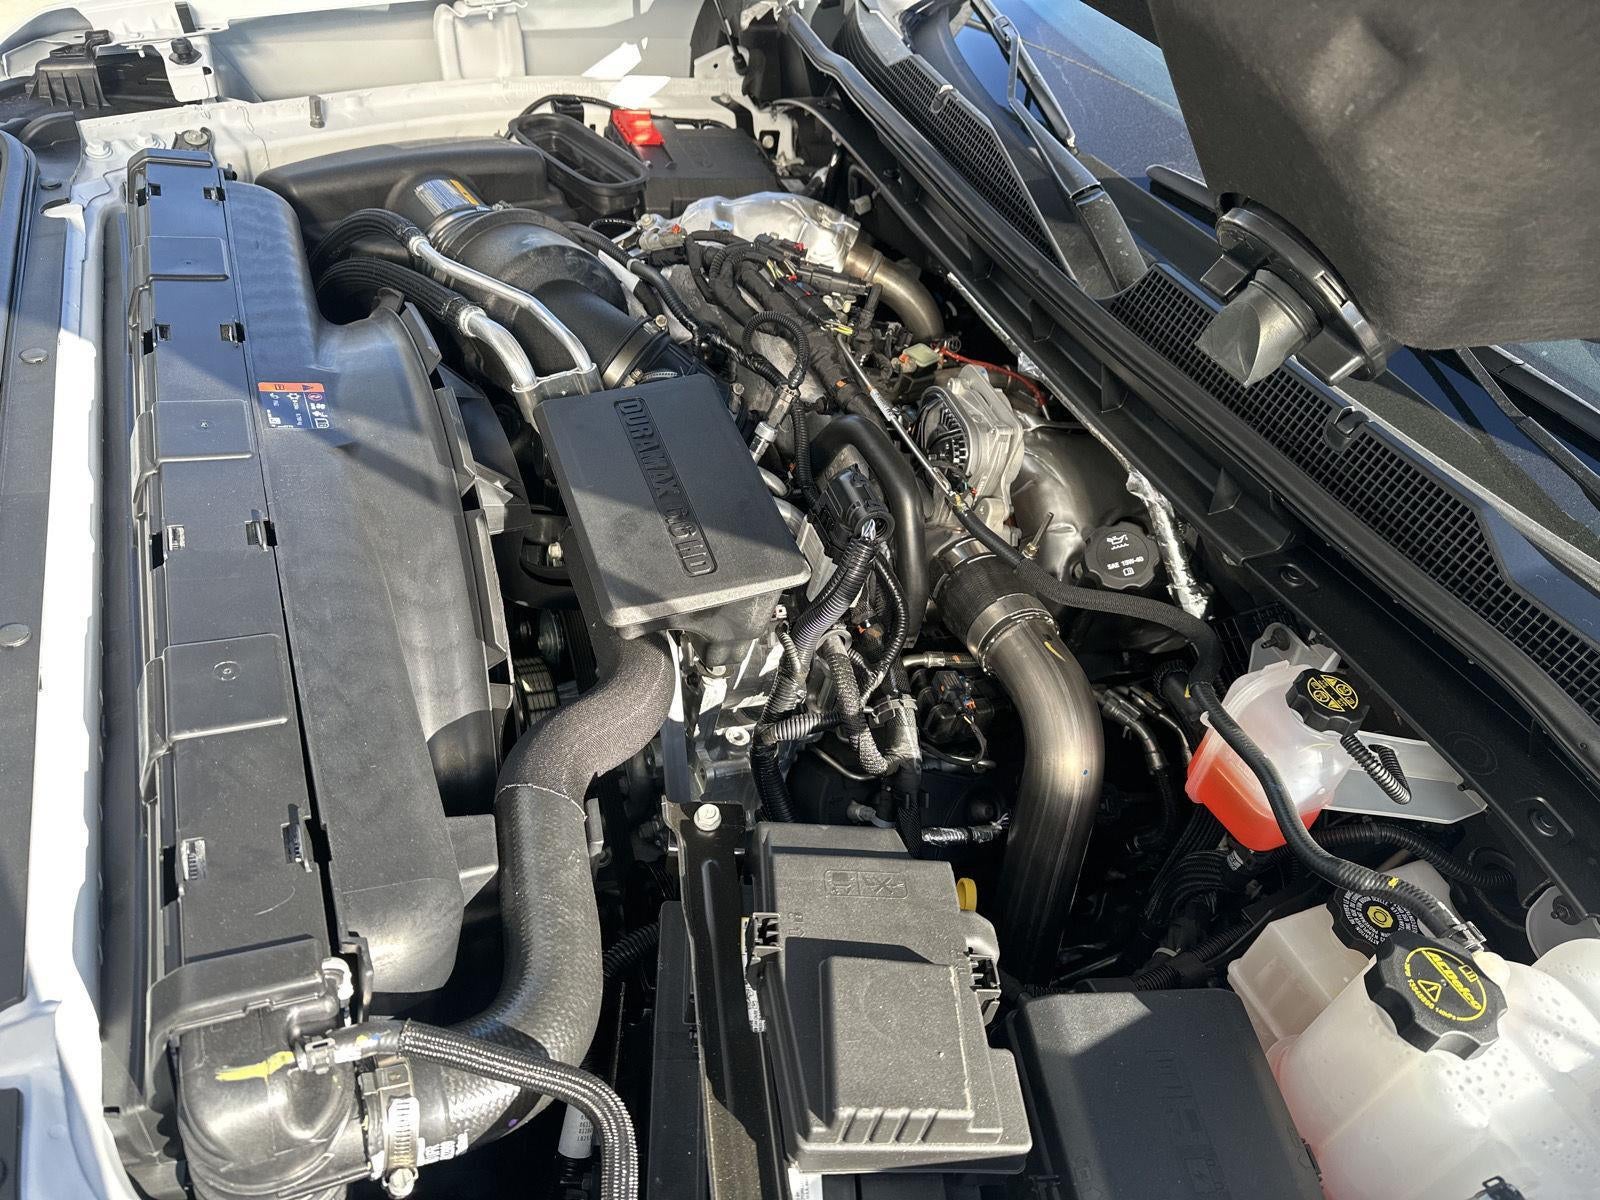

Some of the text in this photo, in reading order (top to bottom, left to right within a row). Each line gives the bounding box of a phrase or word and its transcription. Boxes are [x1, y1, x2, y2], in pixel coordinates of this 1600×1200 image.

[620, 400, 713, 575] DURAMAX 6.6 HD
[1121, 555, 1144, 567] 15W-40
[1426, 952, 1482, 1010] ACDelco
